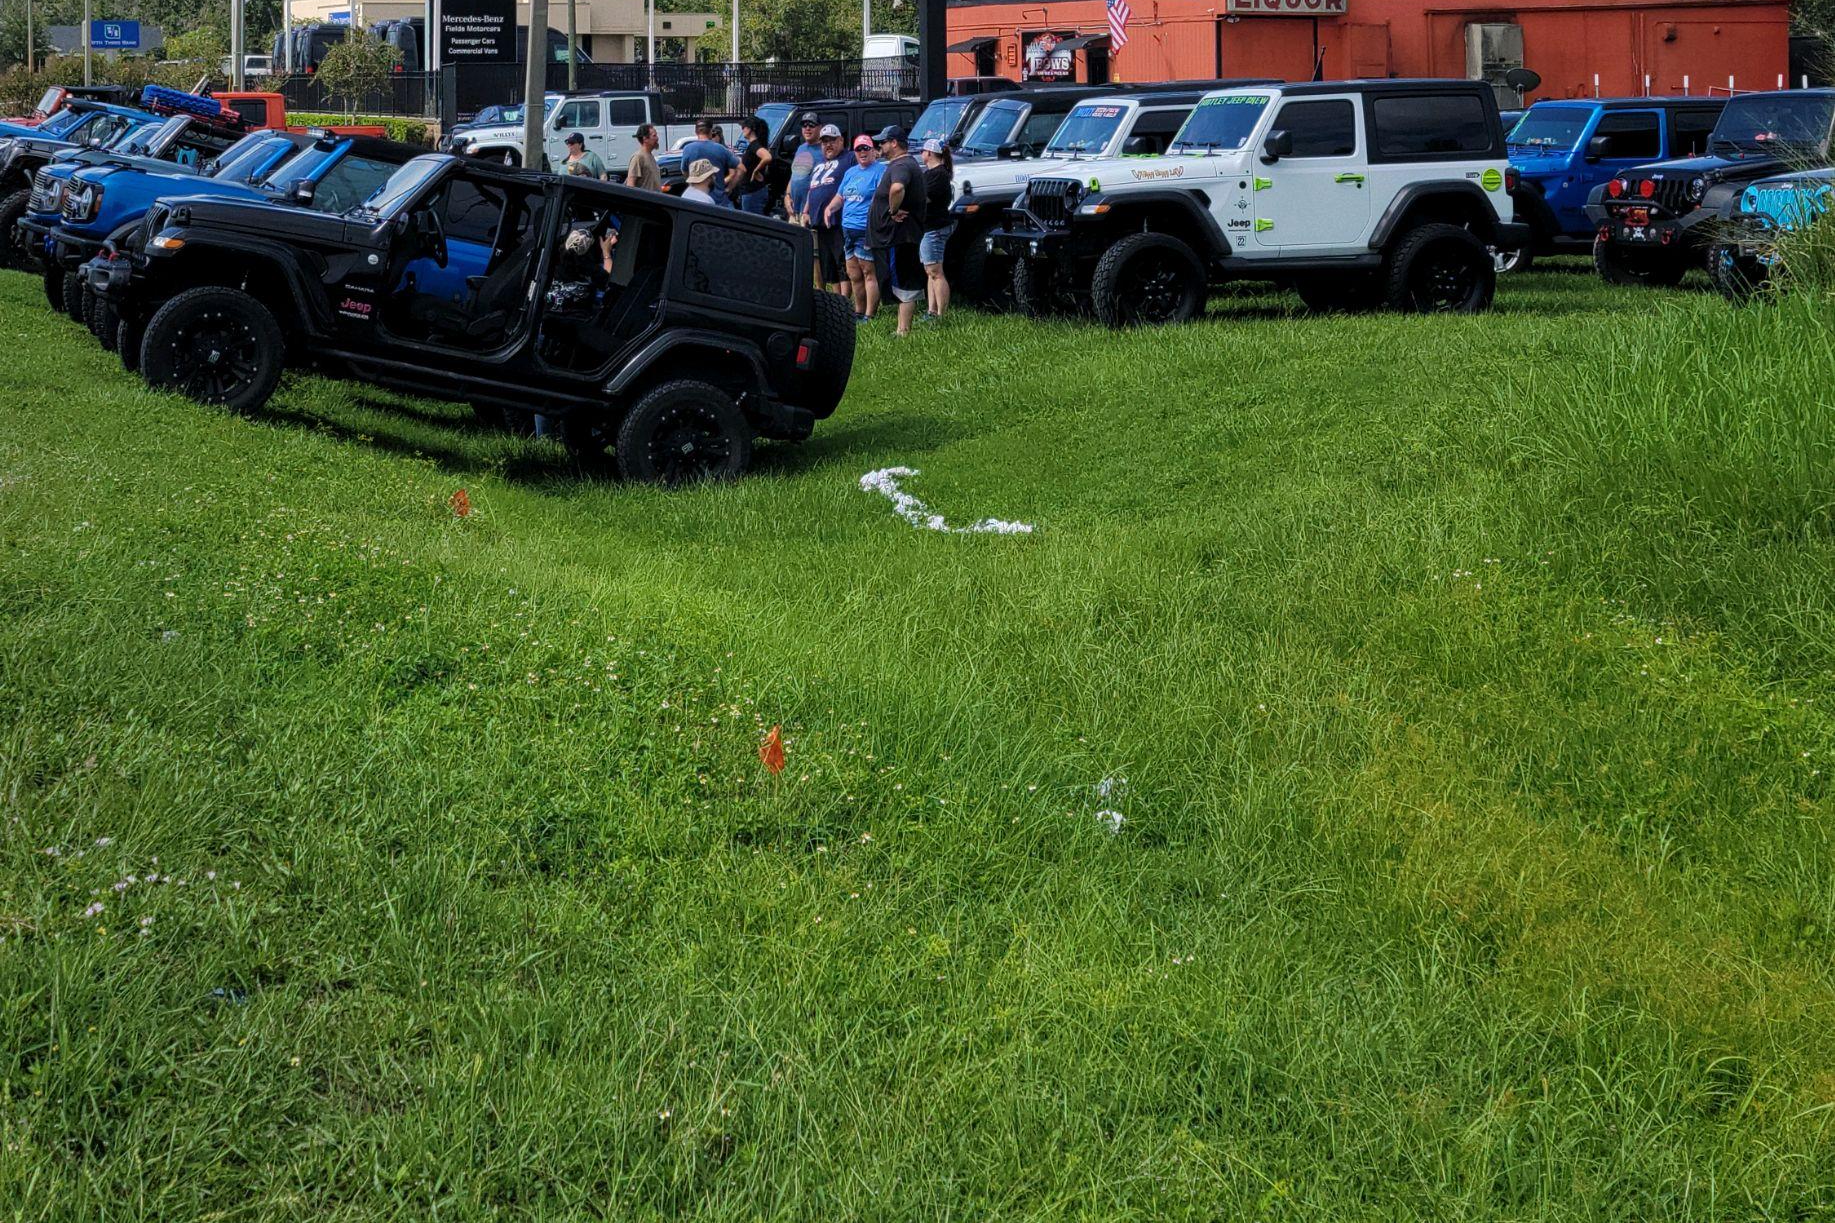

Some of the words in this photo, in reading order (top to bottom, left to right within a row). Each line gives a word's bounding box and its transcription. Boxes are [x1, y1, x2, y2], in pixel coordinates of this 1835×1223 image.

[442, 14, 504, 23] Mercedes-Benz
[451, 37, 481, 46] Passenger
[481, 37, 496, 45] Cars
[448, 47, 483, 55] Commercial
[483, 47, 499, 55] Vans
[810, 159, 839, 189] 22
[1227, 219, 1251, 228] Jeep
[340, 297, 372, 313] Jeep
